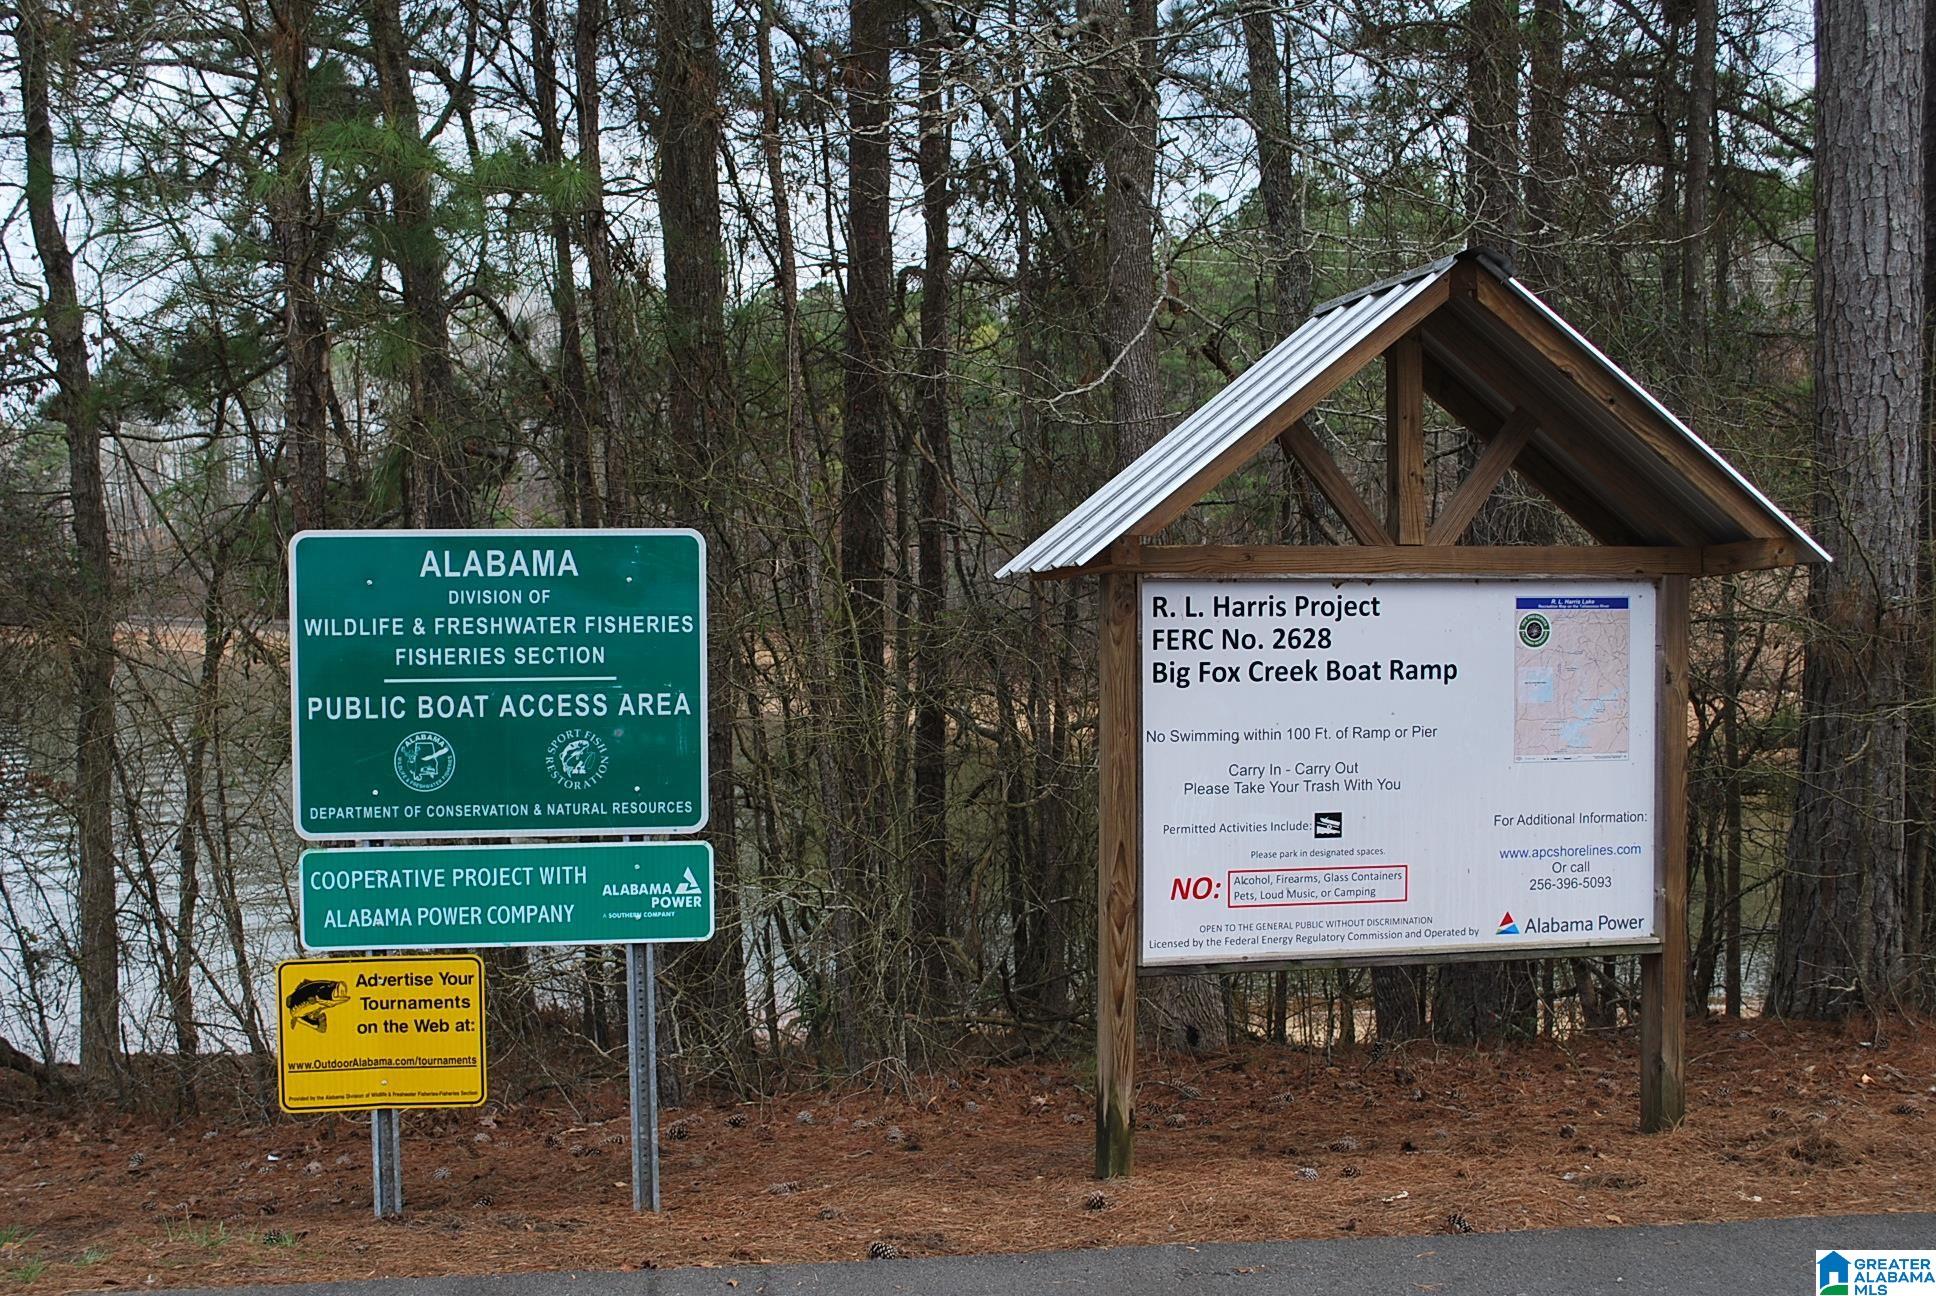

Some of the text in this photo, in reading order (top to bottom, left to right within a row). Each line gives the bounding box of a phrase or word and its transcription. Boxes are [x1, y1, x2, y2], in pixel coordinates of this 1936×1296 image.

[419, 549, 579, 578] ALABAMA
[448, 590, 551, 605] DIVISION OF
[1152, 595, 1381, 622] R. L. Harris Project
[304, 615, 693, 637] WILDLIFE & FRESHWATER FISHERIES
[1152, 627, 1332, 650] FERC No. 2628
[395, 646, 605, 666] FISHERIES SECTION
[1152, 659, 1457, 688] Big Fox Creek Boat Ramp
[307, 693, 691, 720] PUBLIC BOAT ACCESS AREA
[405, 734, 445, 747] ALABAMA
[547, 729, 607, 755] SPORT FISH
[1146, 726, 1438, 744] No Swimming within 100 Ft. of Ramp or Pier
[546, 756, 609, 790] RESTORATION
[1228, 764, 1265, 779] Carry
[1269, 764, 1281, 775] In
[1295, 763, 1332, 777] Carry
[1335, 762, 1359, 774] Out
[1184, 778, 1401, 795] Please Take Your Trash With You
[310, 801, 693, 820] DEPARTMENT OF CONSERVATION & NATURAL RESOURCES
[1494, 812, 1648, 826] For Additional Information:
[1163, 821, 1312, 835] Permitted Activities Include:
[1251, 851, 1277, 859] Please
[1280, 850, 1297, 859] park
[1310, 849, 1354, 858] designated
[1500, 844, 1641, 860] www.apcshorelines.com
[1552, 861, 1590, 873] Or call
[310, 866, 587, 890] COOPERATIVE PROJECT WITH
[1234, 871, 1402, 886] Alcohol, Firearms, Glass Containers
[1529, 876, 1612, 890] 256-396-5093
[602, 883, 672, 896] ALABAMA
[1170, 877, 1221, 900] NO:
[1234, 887, 1376, 901] Pets, Loud Music, or Camping
[652, 896, 702, 908] POWER
[324, 904, 575, 929] ALABAMA POWER COMPANY
[1200, 925, 1222, 933] OPEN
[1256, 922, 1293, 931] GENERAL
[1295, 920, 1324, 929] PUBLIC
[1326, 919, 1364, 928] WITHOUT
[1367, 917, 1433, 926] DISCRIMINATION
[1525, 915, 1644, 934] Alabama Power
[1149, 927, 1479, 948] Licensed by the Federal Energy Regulatory Commission and Operated by
[356, 972, 474, 988] Advertise Your
[359, 996, 471, 1011] Tournaments
[357, 1019, 475, 1035] on the Web at:
[288, 1055, 477, 1070] www.OutdoorAlabama.com/tournaments
